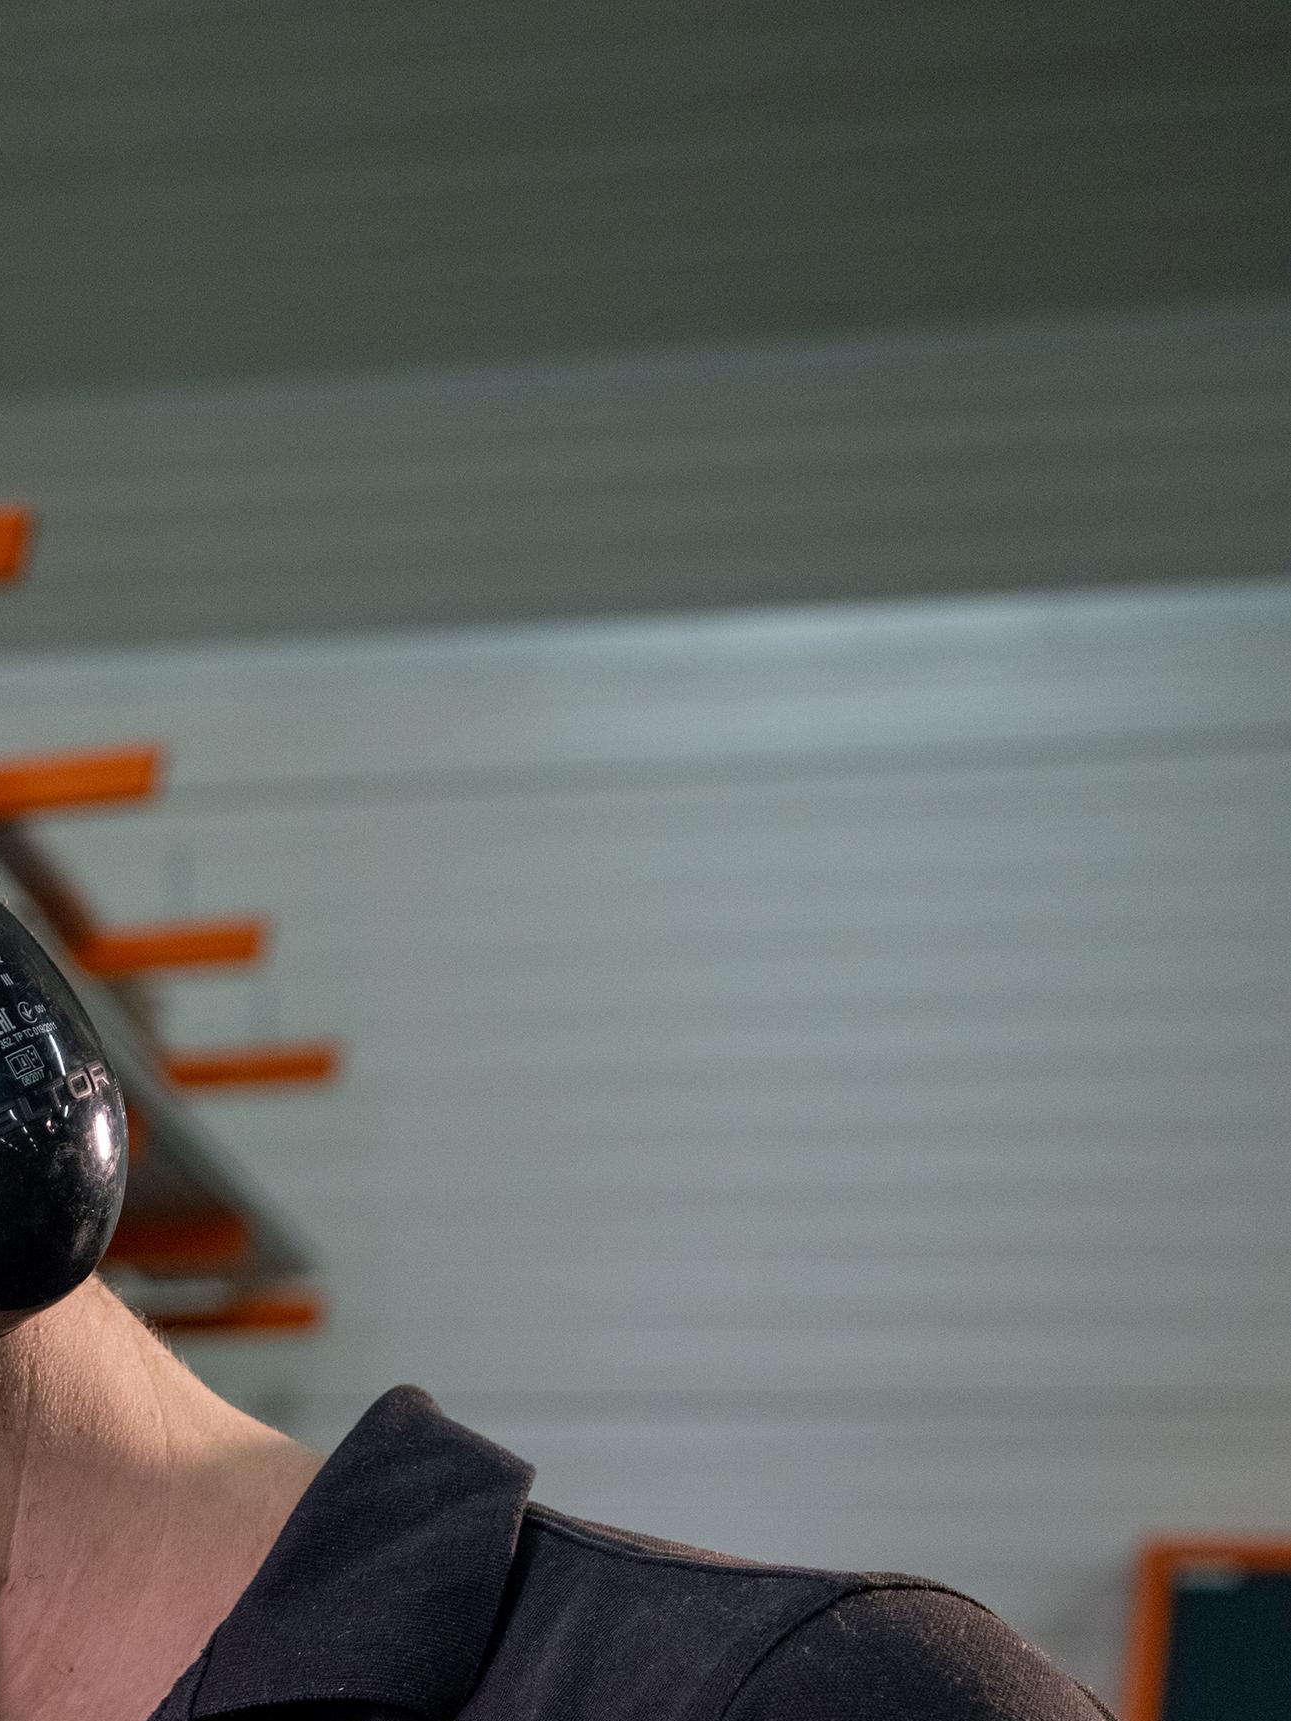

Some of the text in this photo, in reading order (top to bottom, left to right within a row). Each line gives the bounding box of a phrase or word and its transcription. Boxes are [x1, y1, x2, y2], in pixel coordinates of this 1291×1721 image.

[0, 972, 15, 987] III
[12, 1031, 24, 1043] TP
[22, 1027, 34, 1038] TC
